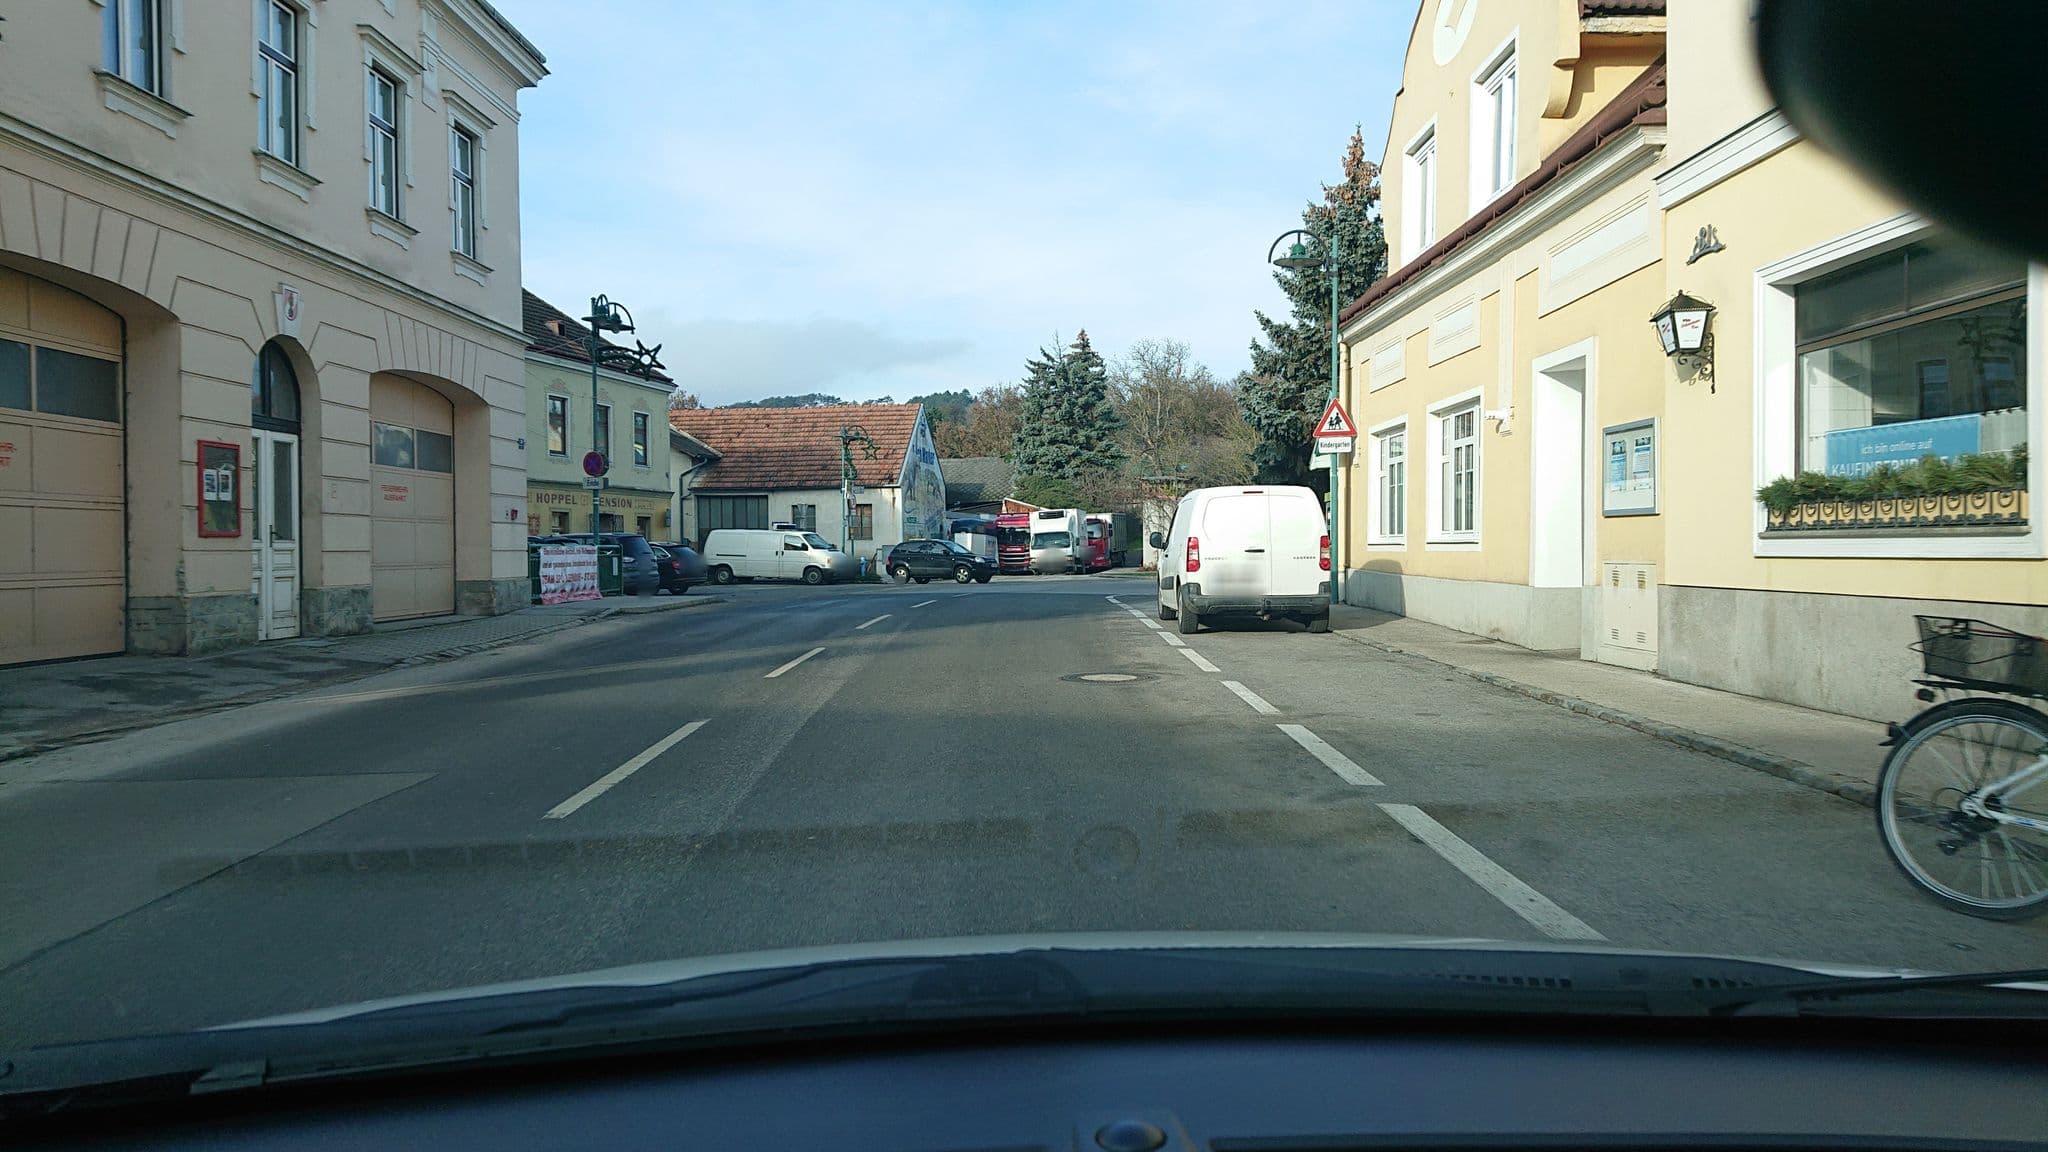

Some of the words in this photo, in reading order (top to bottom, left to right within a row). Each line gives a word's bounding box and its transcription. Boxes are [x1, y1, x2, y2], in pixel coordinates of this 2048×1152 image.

[1320, 441, 1351, 450] Kindergarten
[1889, 441, 1917, 452] online
[1918, 437, 1934, 449] auf
[536, 492, 577, 505] HOPPEL
[596, 496, 632, 508] ENSION
